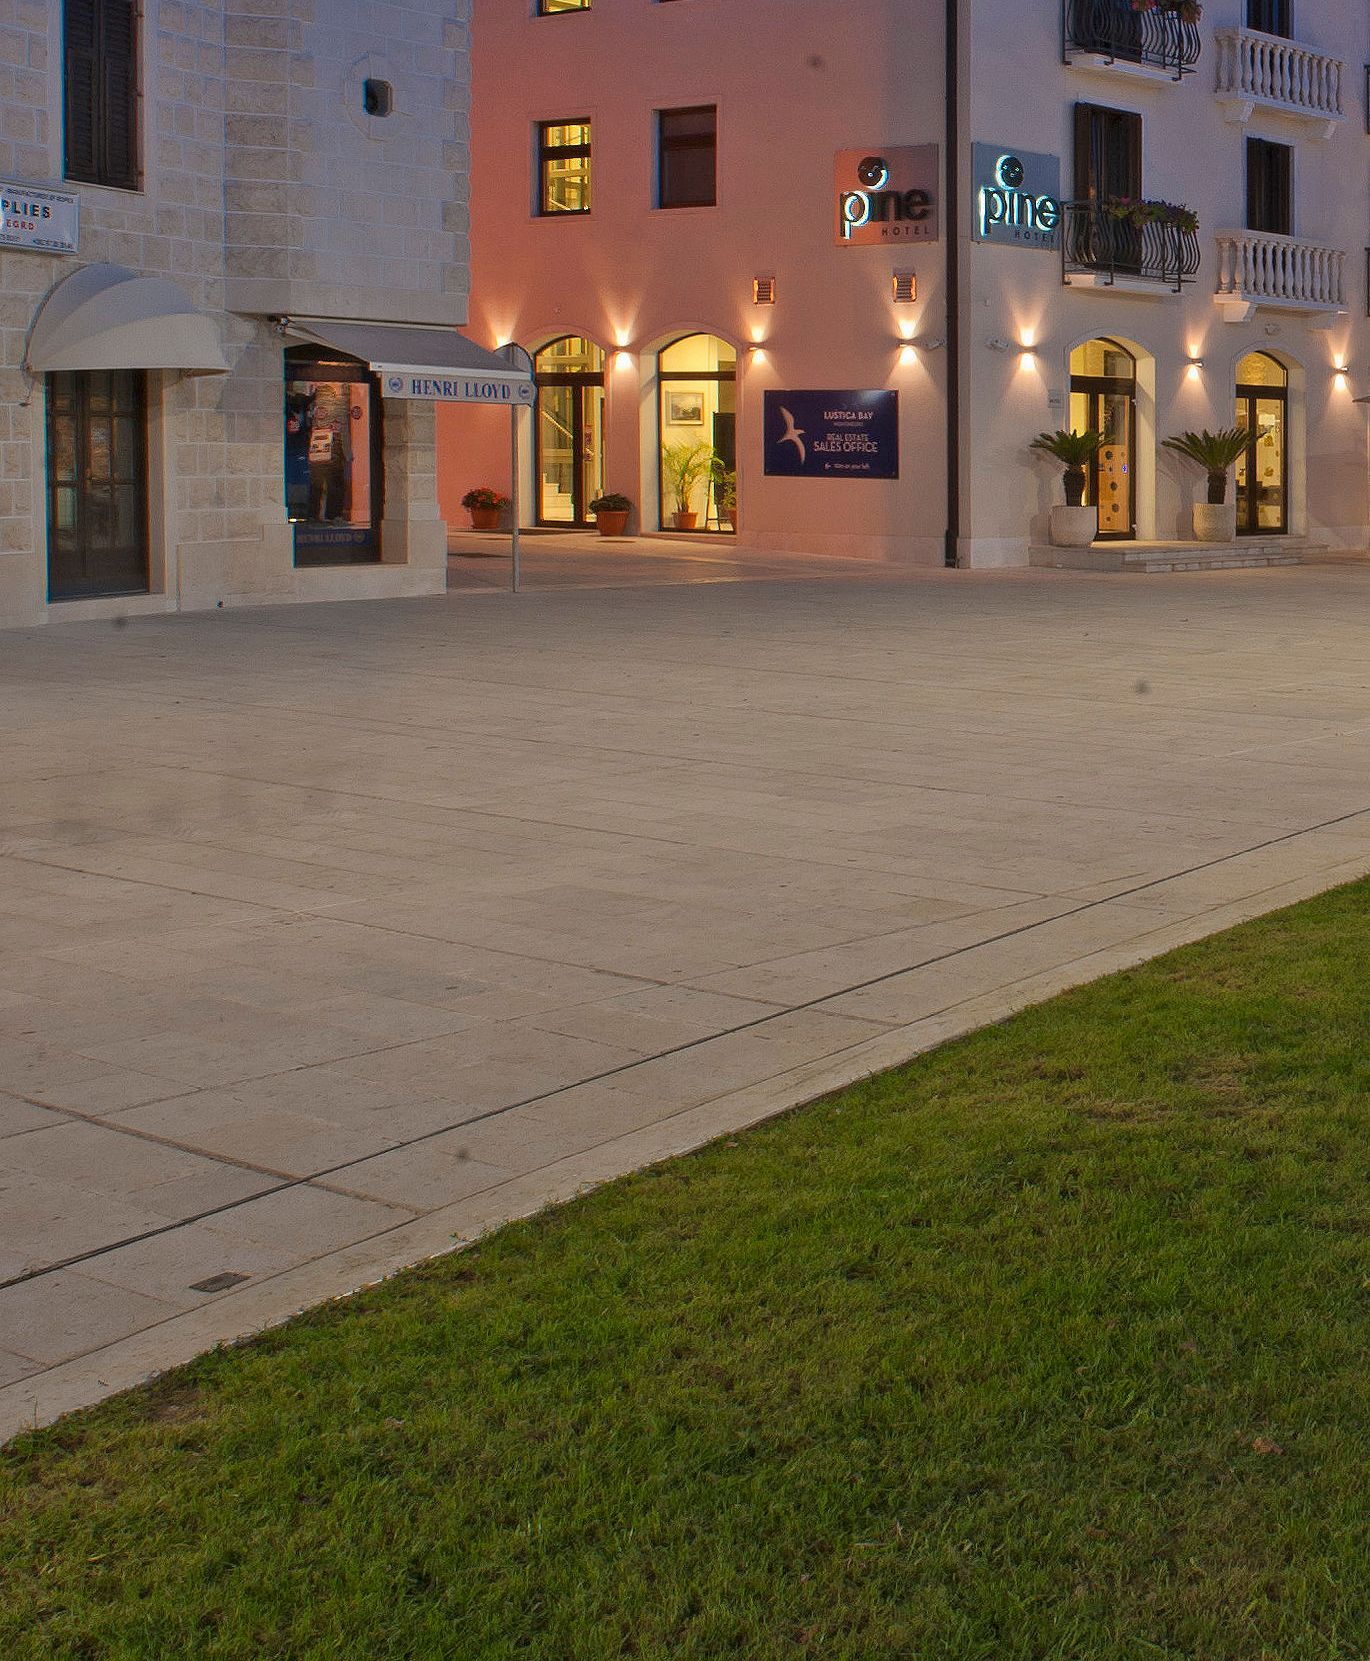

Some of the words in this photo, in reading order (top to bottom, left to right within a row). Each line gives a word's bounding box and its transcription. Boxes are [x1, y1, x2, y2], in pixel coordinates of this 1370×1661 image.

[840, 189, 930, 239] pine
[979, 187, 1059, 236] pine
[881, 225, 930, 236] HOTEL
[1014, 229, 1055, 244] HOTEL
[412, 379, 458, 397] HENRI
[465, 382, 511, 400] LLOYD
[858, 411, 873, 420] BAY
[826, 433, 843, 441] REAL
[813, 441, 841, 452] SALES
[843, 442, 878, 453] OFFICE
